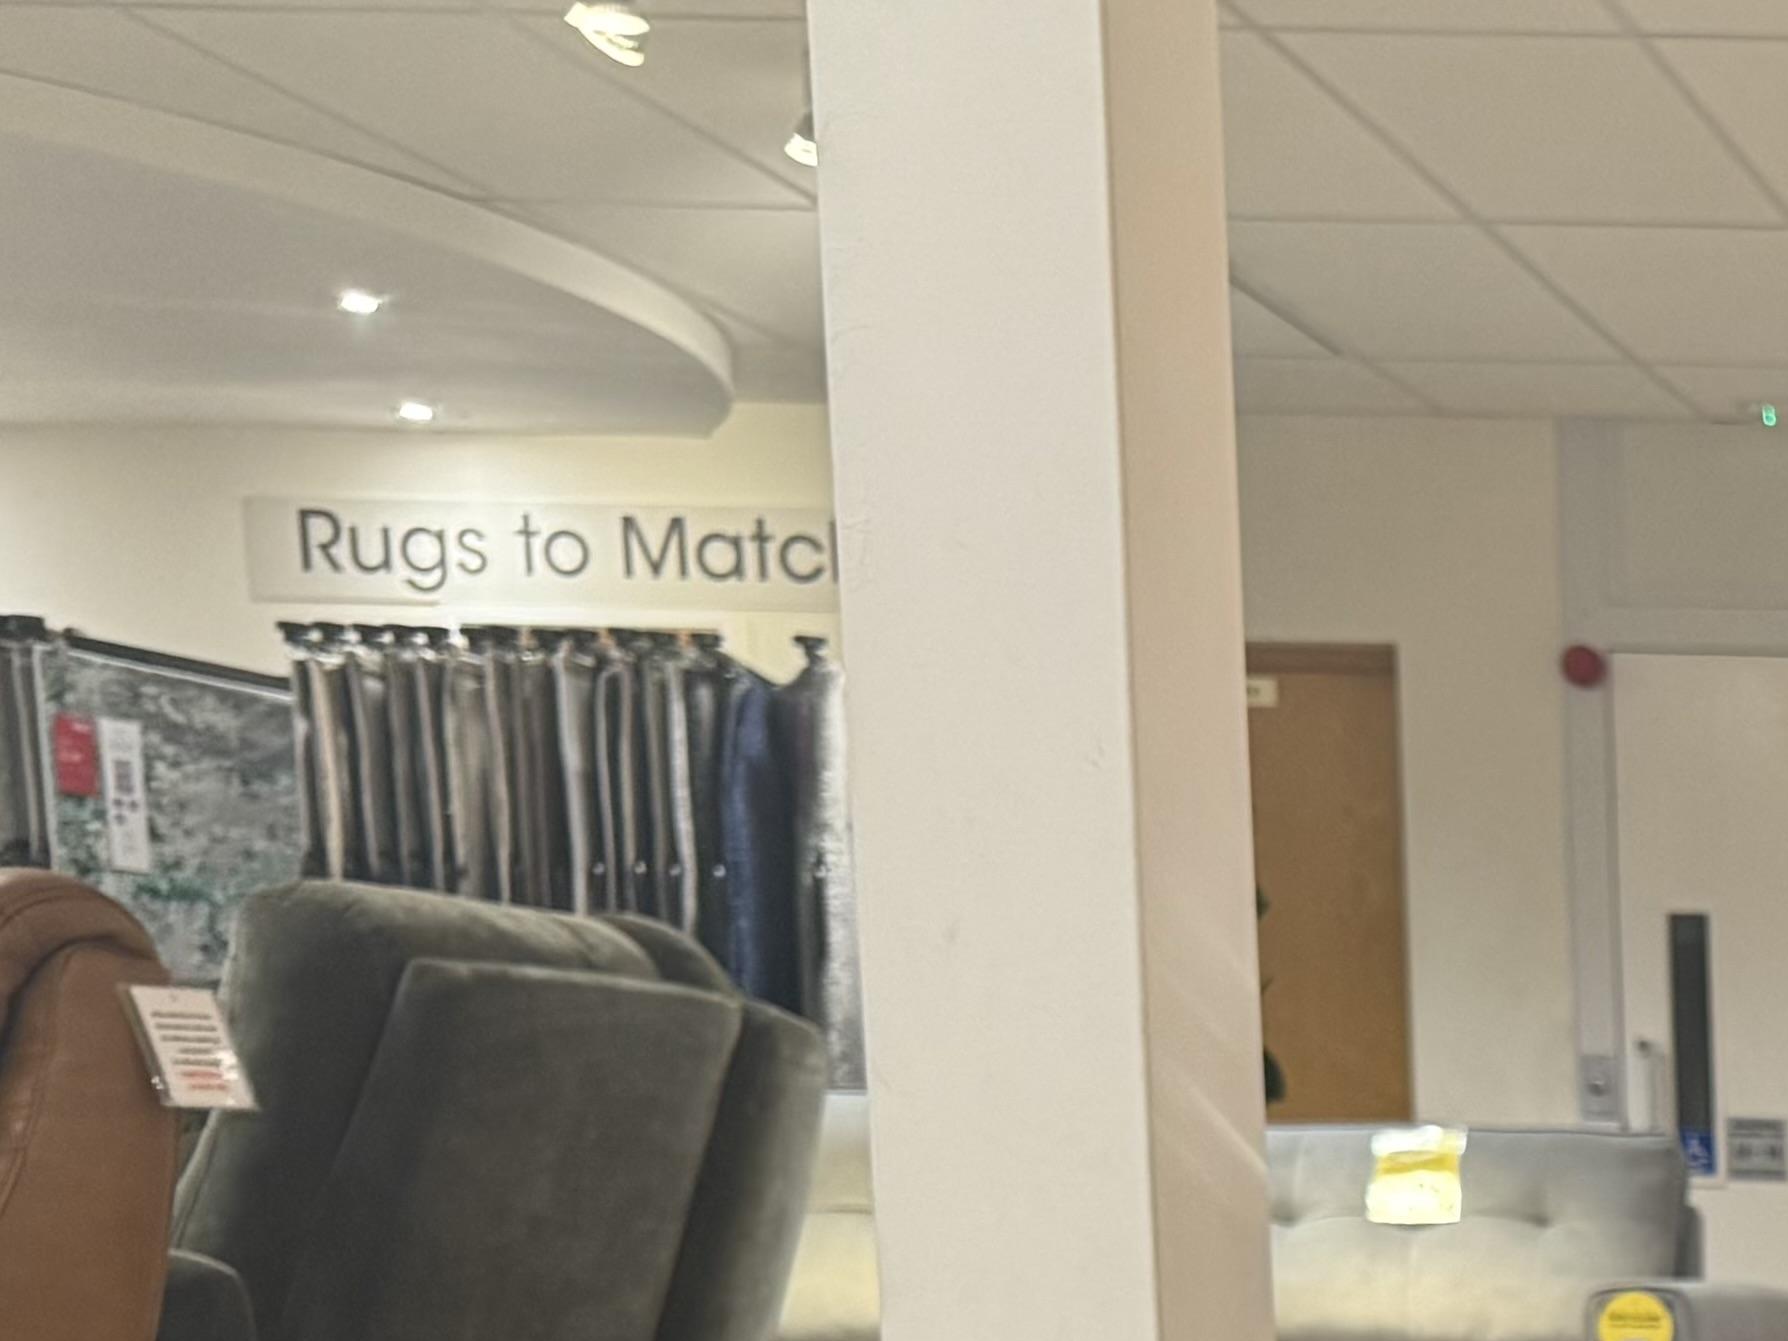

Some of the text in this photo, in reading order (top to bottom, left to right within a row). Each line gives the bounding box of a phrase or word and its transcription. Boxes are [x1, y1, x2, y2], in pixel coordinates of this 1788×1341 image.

[298, 508, 838, 592] Rugs to Matc
